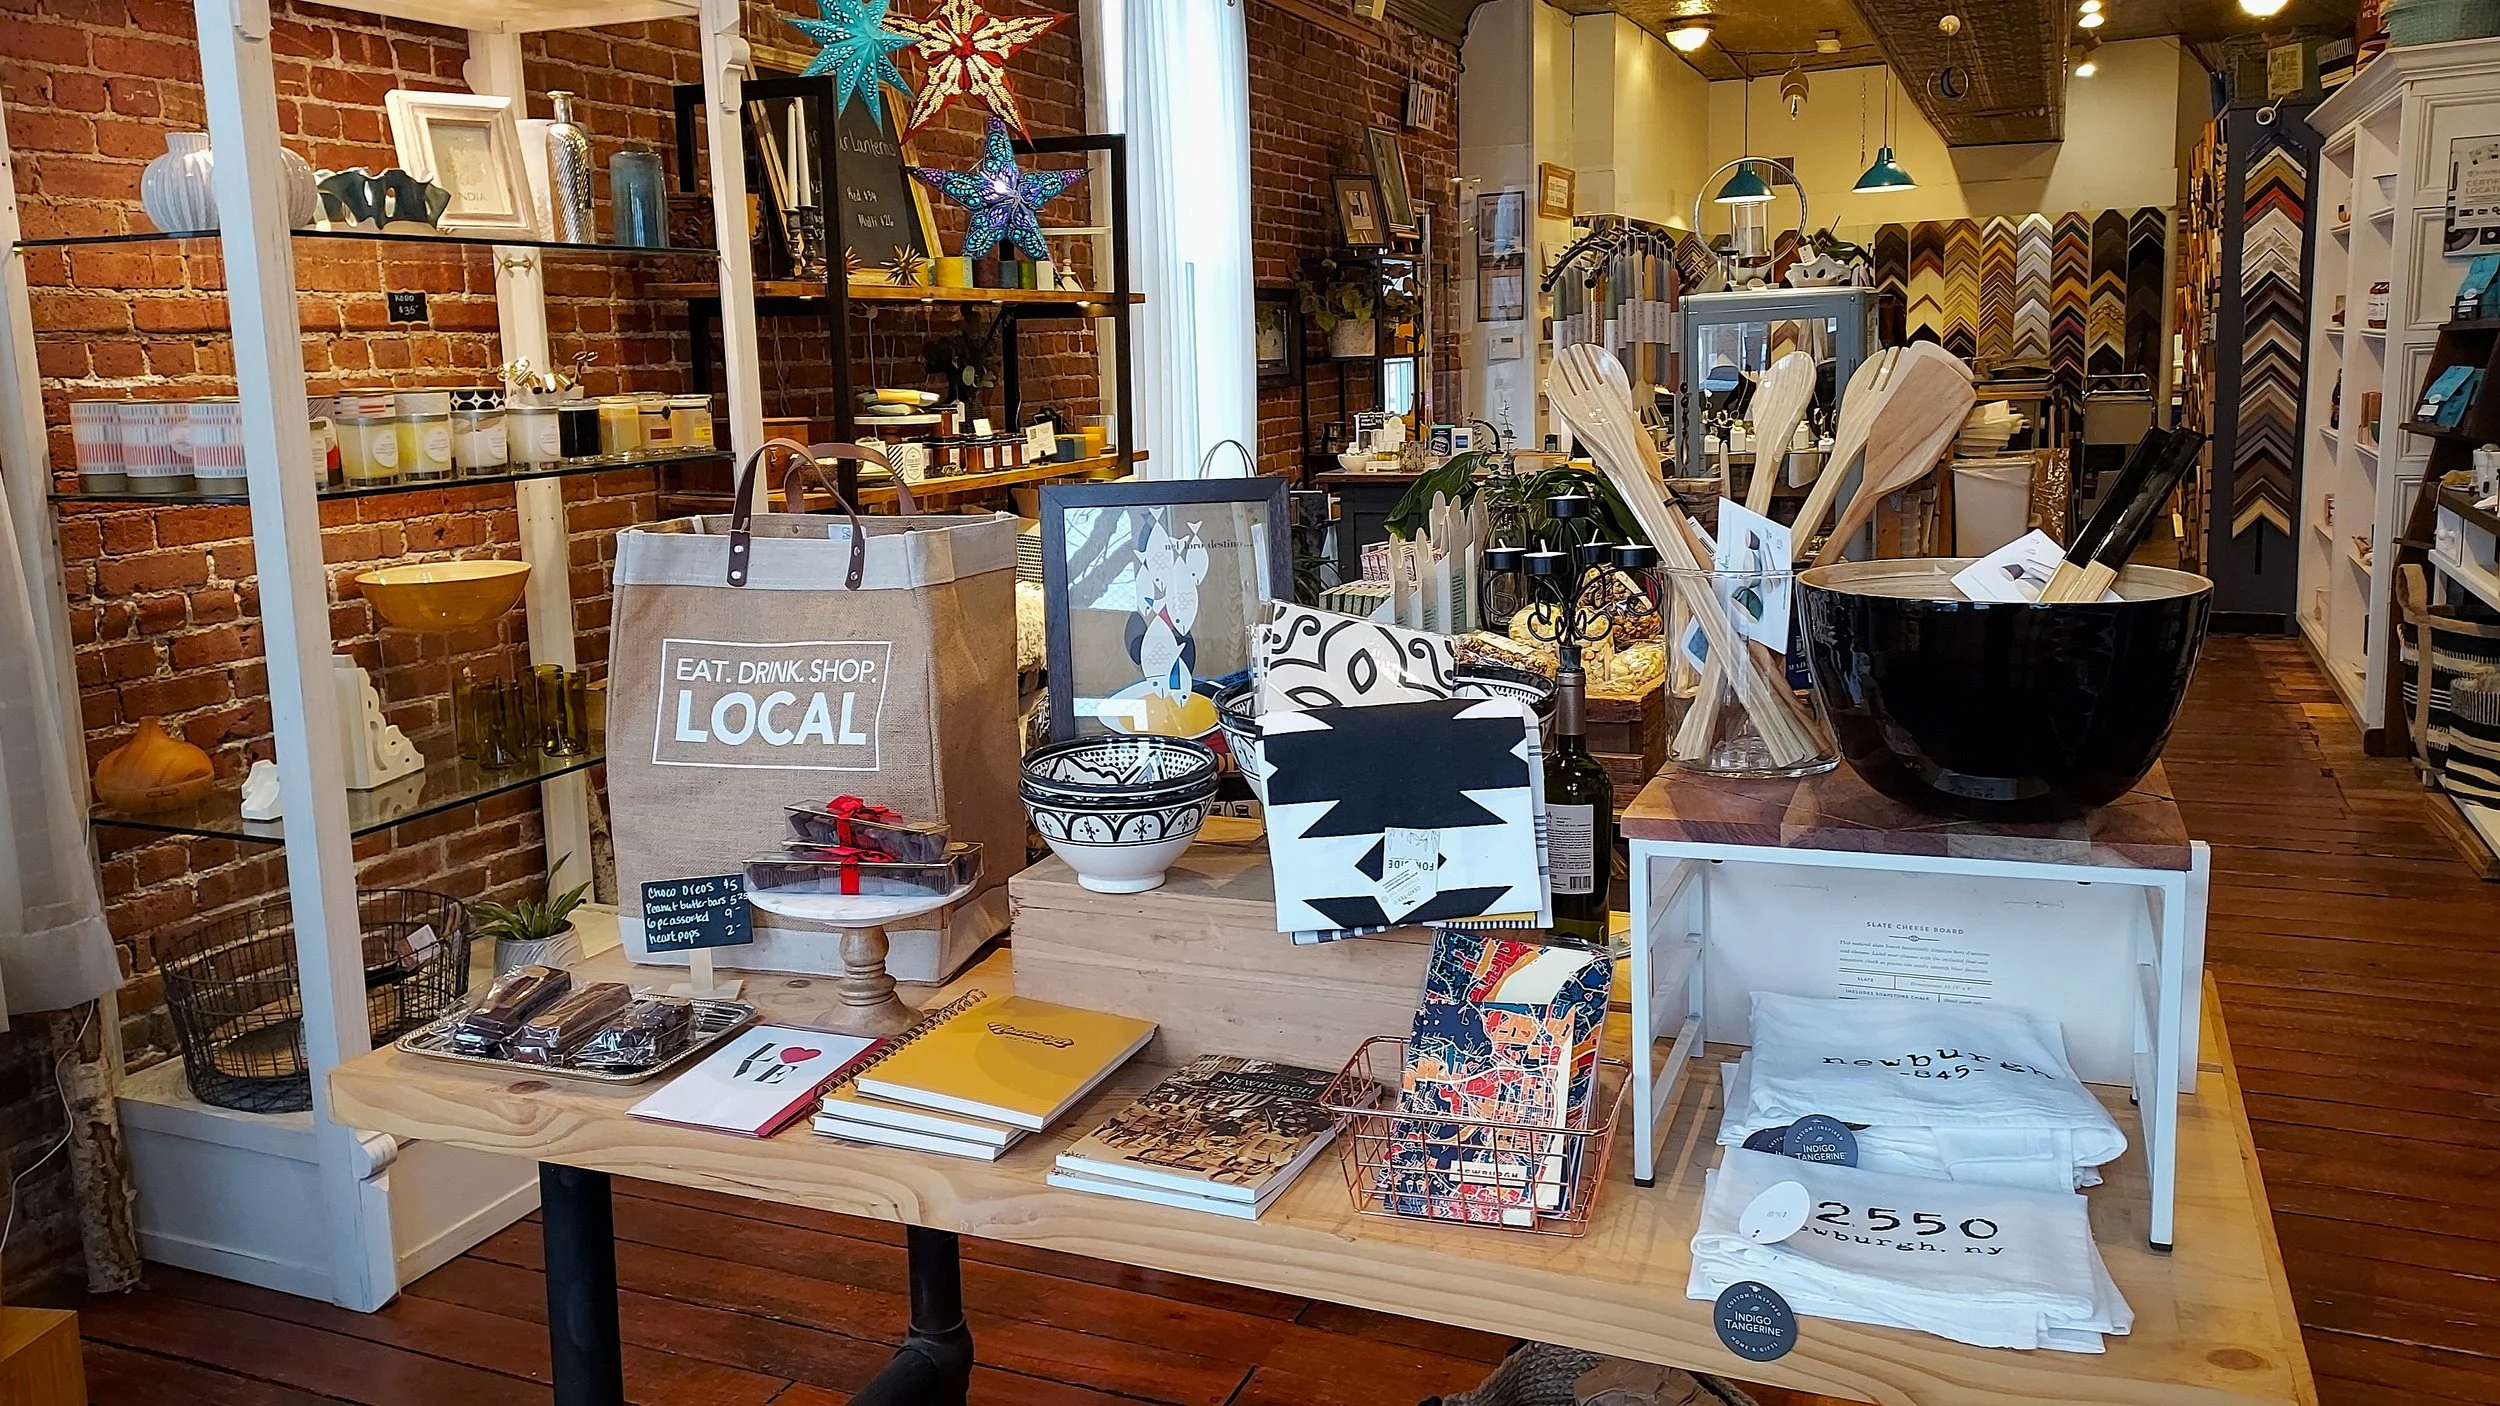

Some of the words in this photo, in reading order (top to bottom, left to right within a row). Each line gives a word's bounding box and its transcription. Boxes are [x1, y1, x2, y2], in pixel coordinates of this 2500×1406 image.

[848, 128, 897, 157] Lanterns
[676, 658, 731, 683] EAT.
[738, 660, 804, 684] DRINK.
[809, 659, 877, 683] SHOP.
[675, 690, 867, 746] LOCAL
[648, 887, 676, 899] Choco
[682, 882, 715, 896] Oreos
[723, 879, 738, 891] $5
[646, 901, 678, 915] Peanut
[648, 931, 677, 944] heart
[678, 928, 700, 944] pops
[1866, 921, 1892, 929] SLATE
[1896, 923, 1930, 932] CHEESE
[1933, 927, 1964, 935] BOARD
[1822, 1048, 2056, 1080] newburgh
[1802, 1144, 1836, 1153] INDIGO
[1457, 1168, 1519, 1179] EWBURGH
[1815, 1200, 1998, 1240] 2550
[1964, 1244, 2004, 1255] ny
[1734, 1311, 1772, 1325] INDIGO
